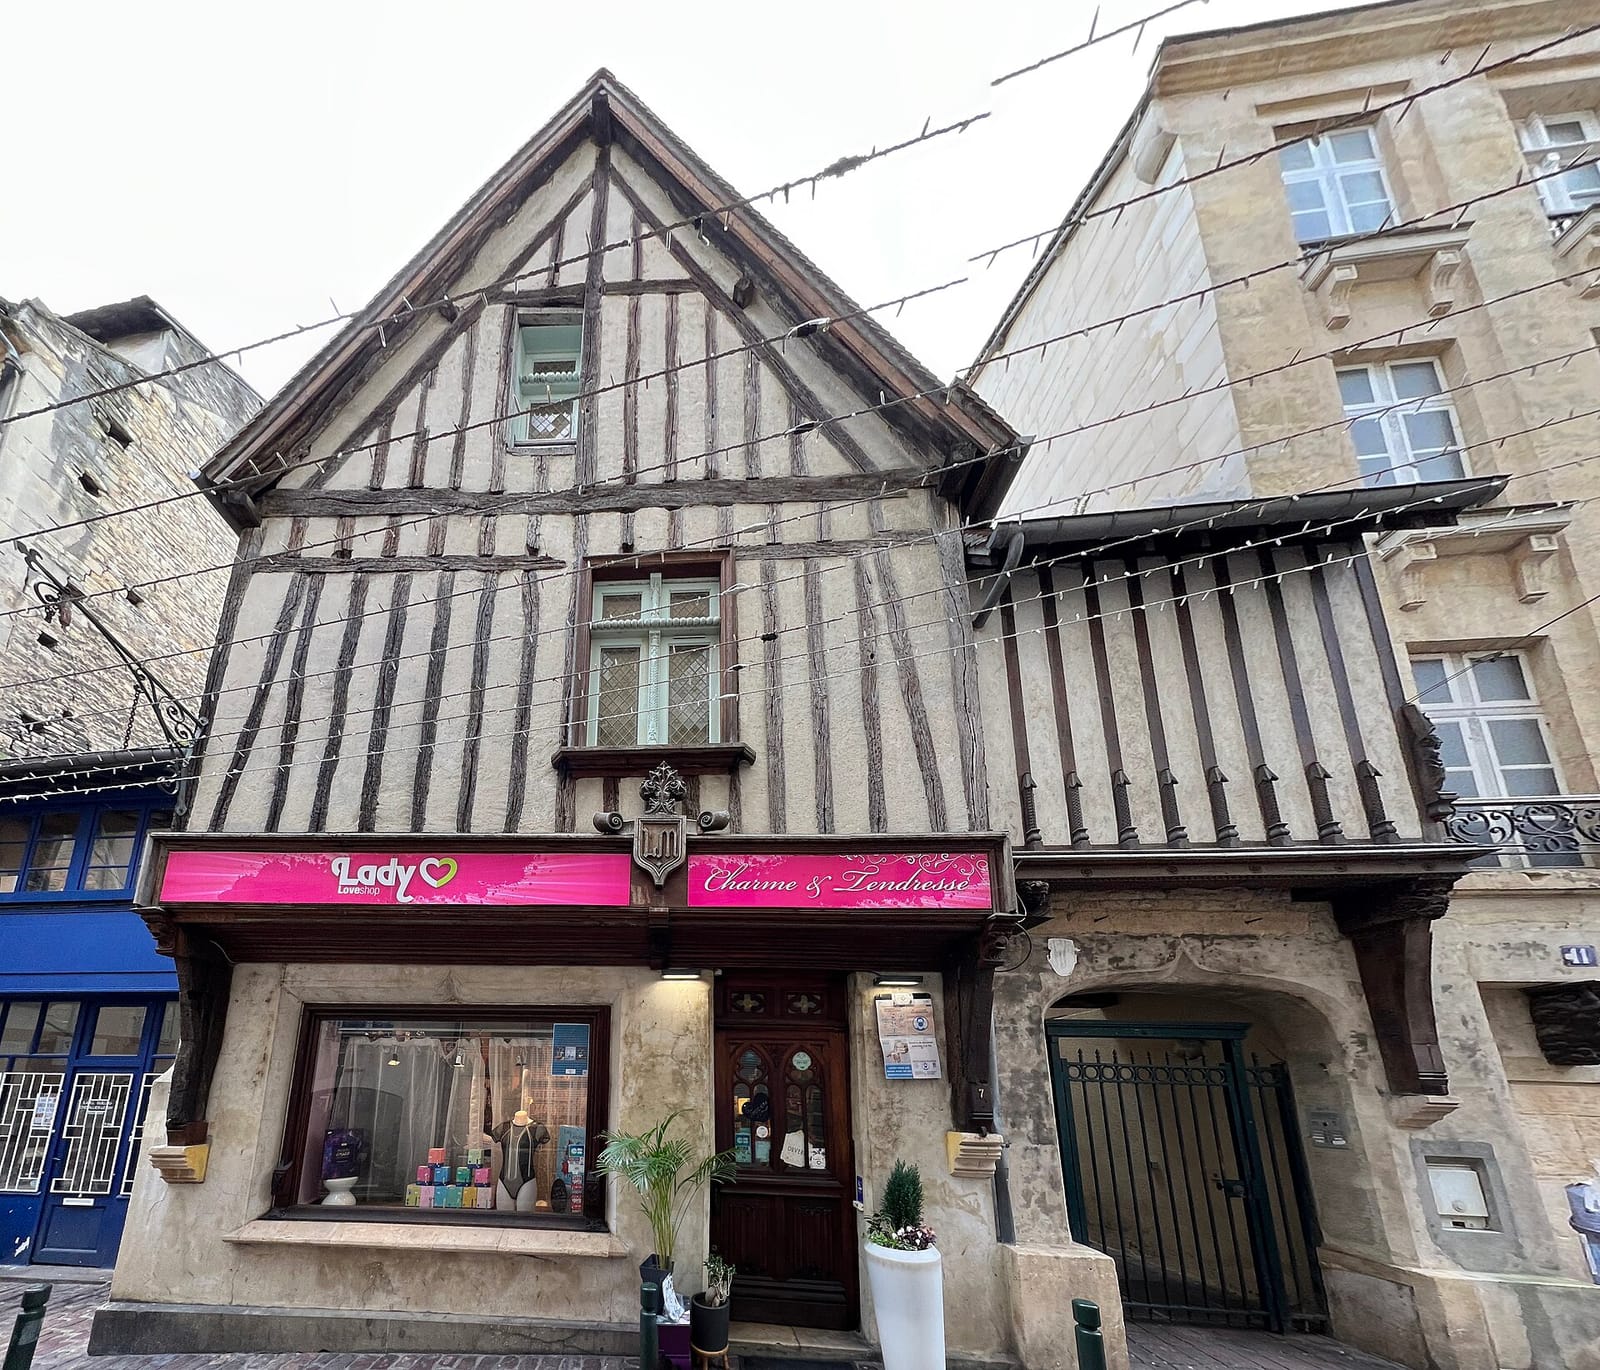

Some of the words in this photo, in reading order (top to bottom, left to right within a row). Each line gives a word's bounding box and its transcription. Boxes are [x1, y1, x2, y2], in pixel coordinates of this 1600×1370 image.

[331, 856, 417, 903] Lady
[704, 863, 798, 891] Charme
[806, 875, 832, 898] &
[833, 865, 971, 891] Tendresse
[338, 885, 380, 896] Loveshop
[1570, 948, 1590, 964] 11
[978, 1088, 985, 1099] 7
